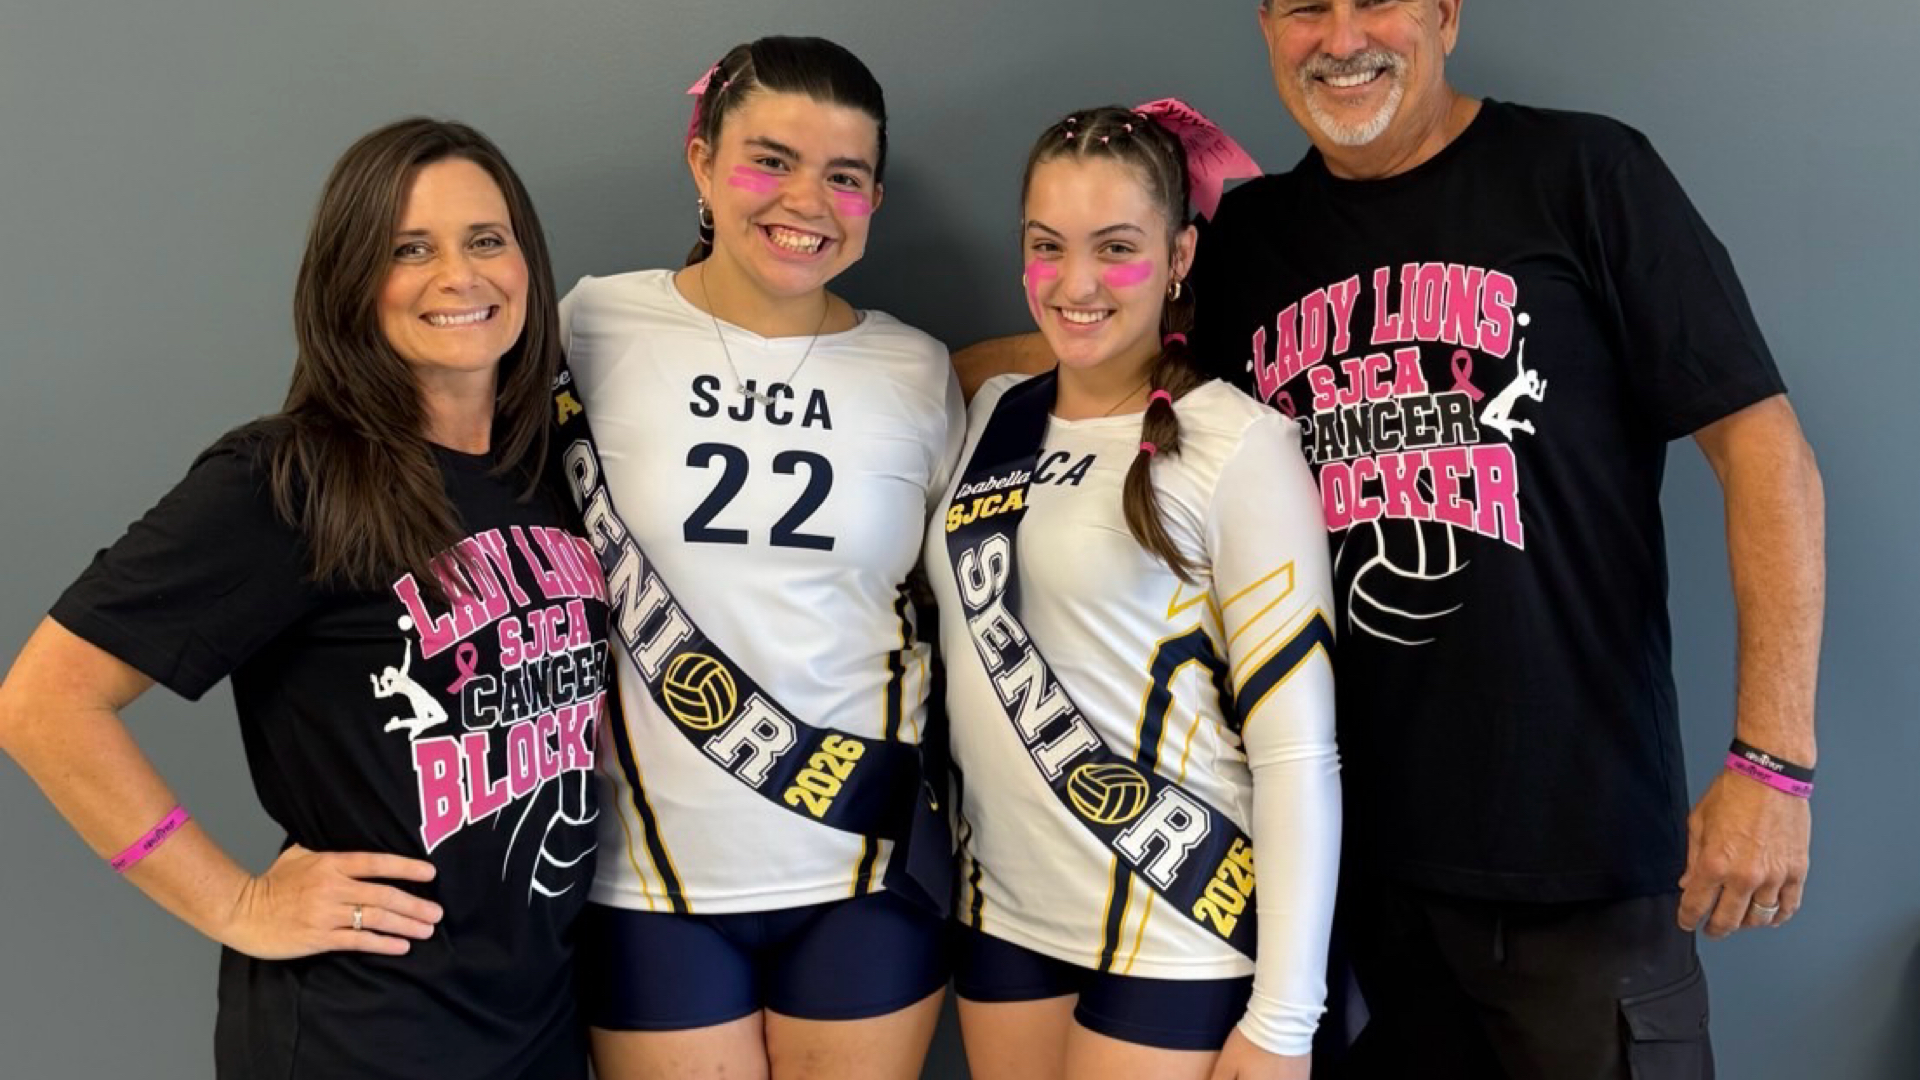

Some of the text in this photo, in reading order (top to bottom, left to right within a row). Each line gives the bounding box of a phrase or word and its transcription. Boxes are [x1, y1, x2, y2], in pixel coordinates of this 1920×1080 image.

[1253, 262, 1518, 404] LADY LIONS
[689, 374, 834, 431] SJCA
[1307, 346, 1429, 412] SJCA
[683, 442, 836, 552] 22
[945, 488, 1025, 534] SJCA
[1032, 449, 1097, 487] CA
[1319, 443, 1525, 551] OCKER
[392, 525, 609, 660] LADY LION
[498, 599, 592, 672] SJCA
[411, 690, 607, 856] BLOCK
[782, 732, 867, 819] 2026
